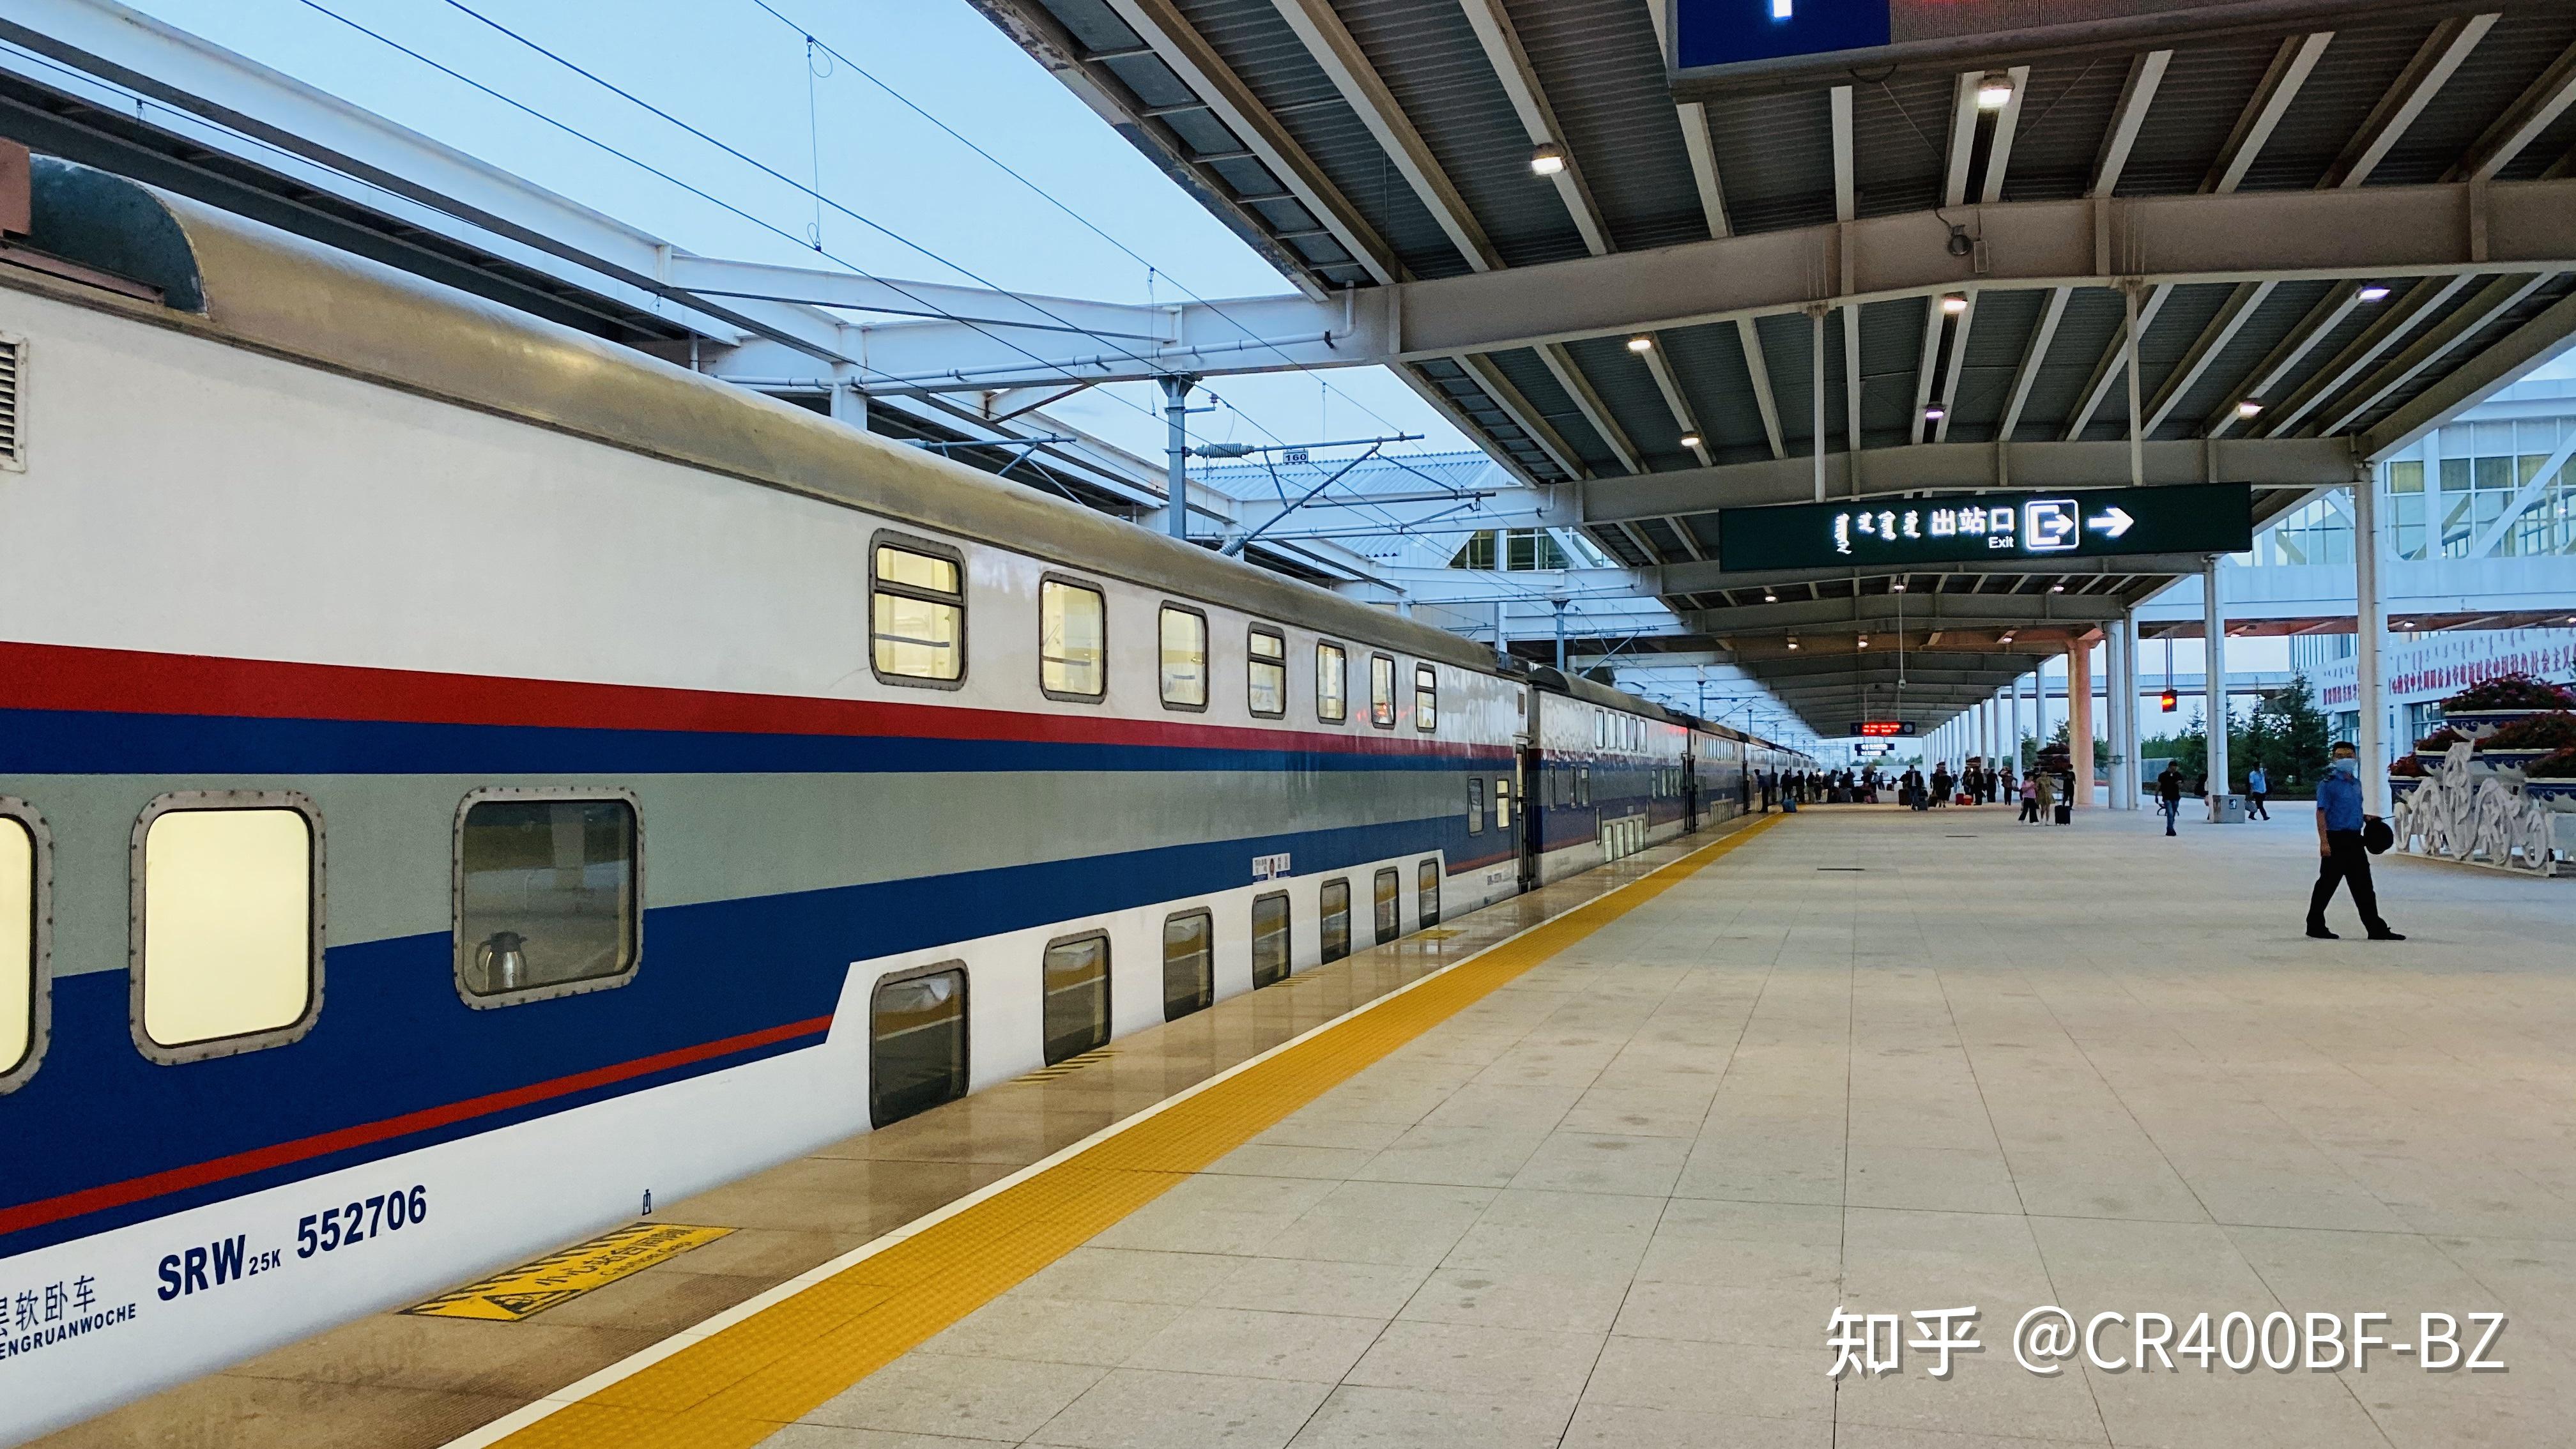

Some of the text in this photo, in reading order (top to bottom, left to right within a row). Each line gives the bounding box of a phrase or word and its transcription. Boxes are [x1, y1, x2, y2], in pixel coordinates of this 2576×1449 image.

[1931, 506, 2015, 536] 出站口
[1988, 535, 2014, 549] Exit
[296, 1184, 427, 1259] 552706
